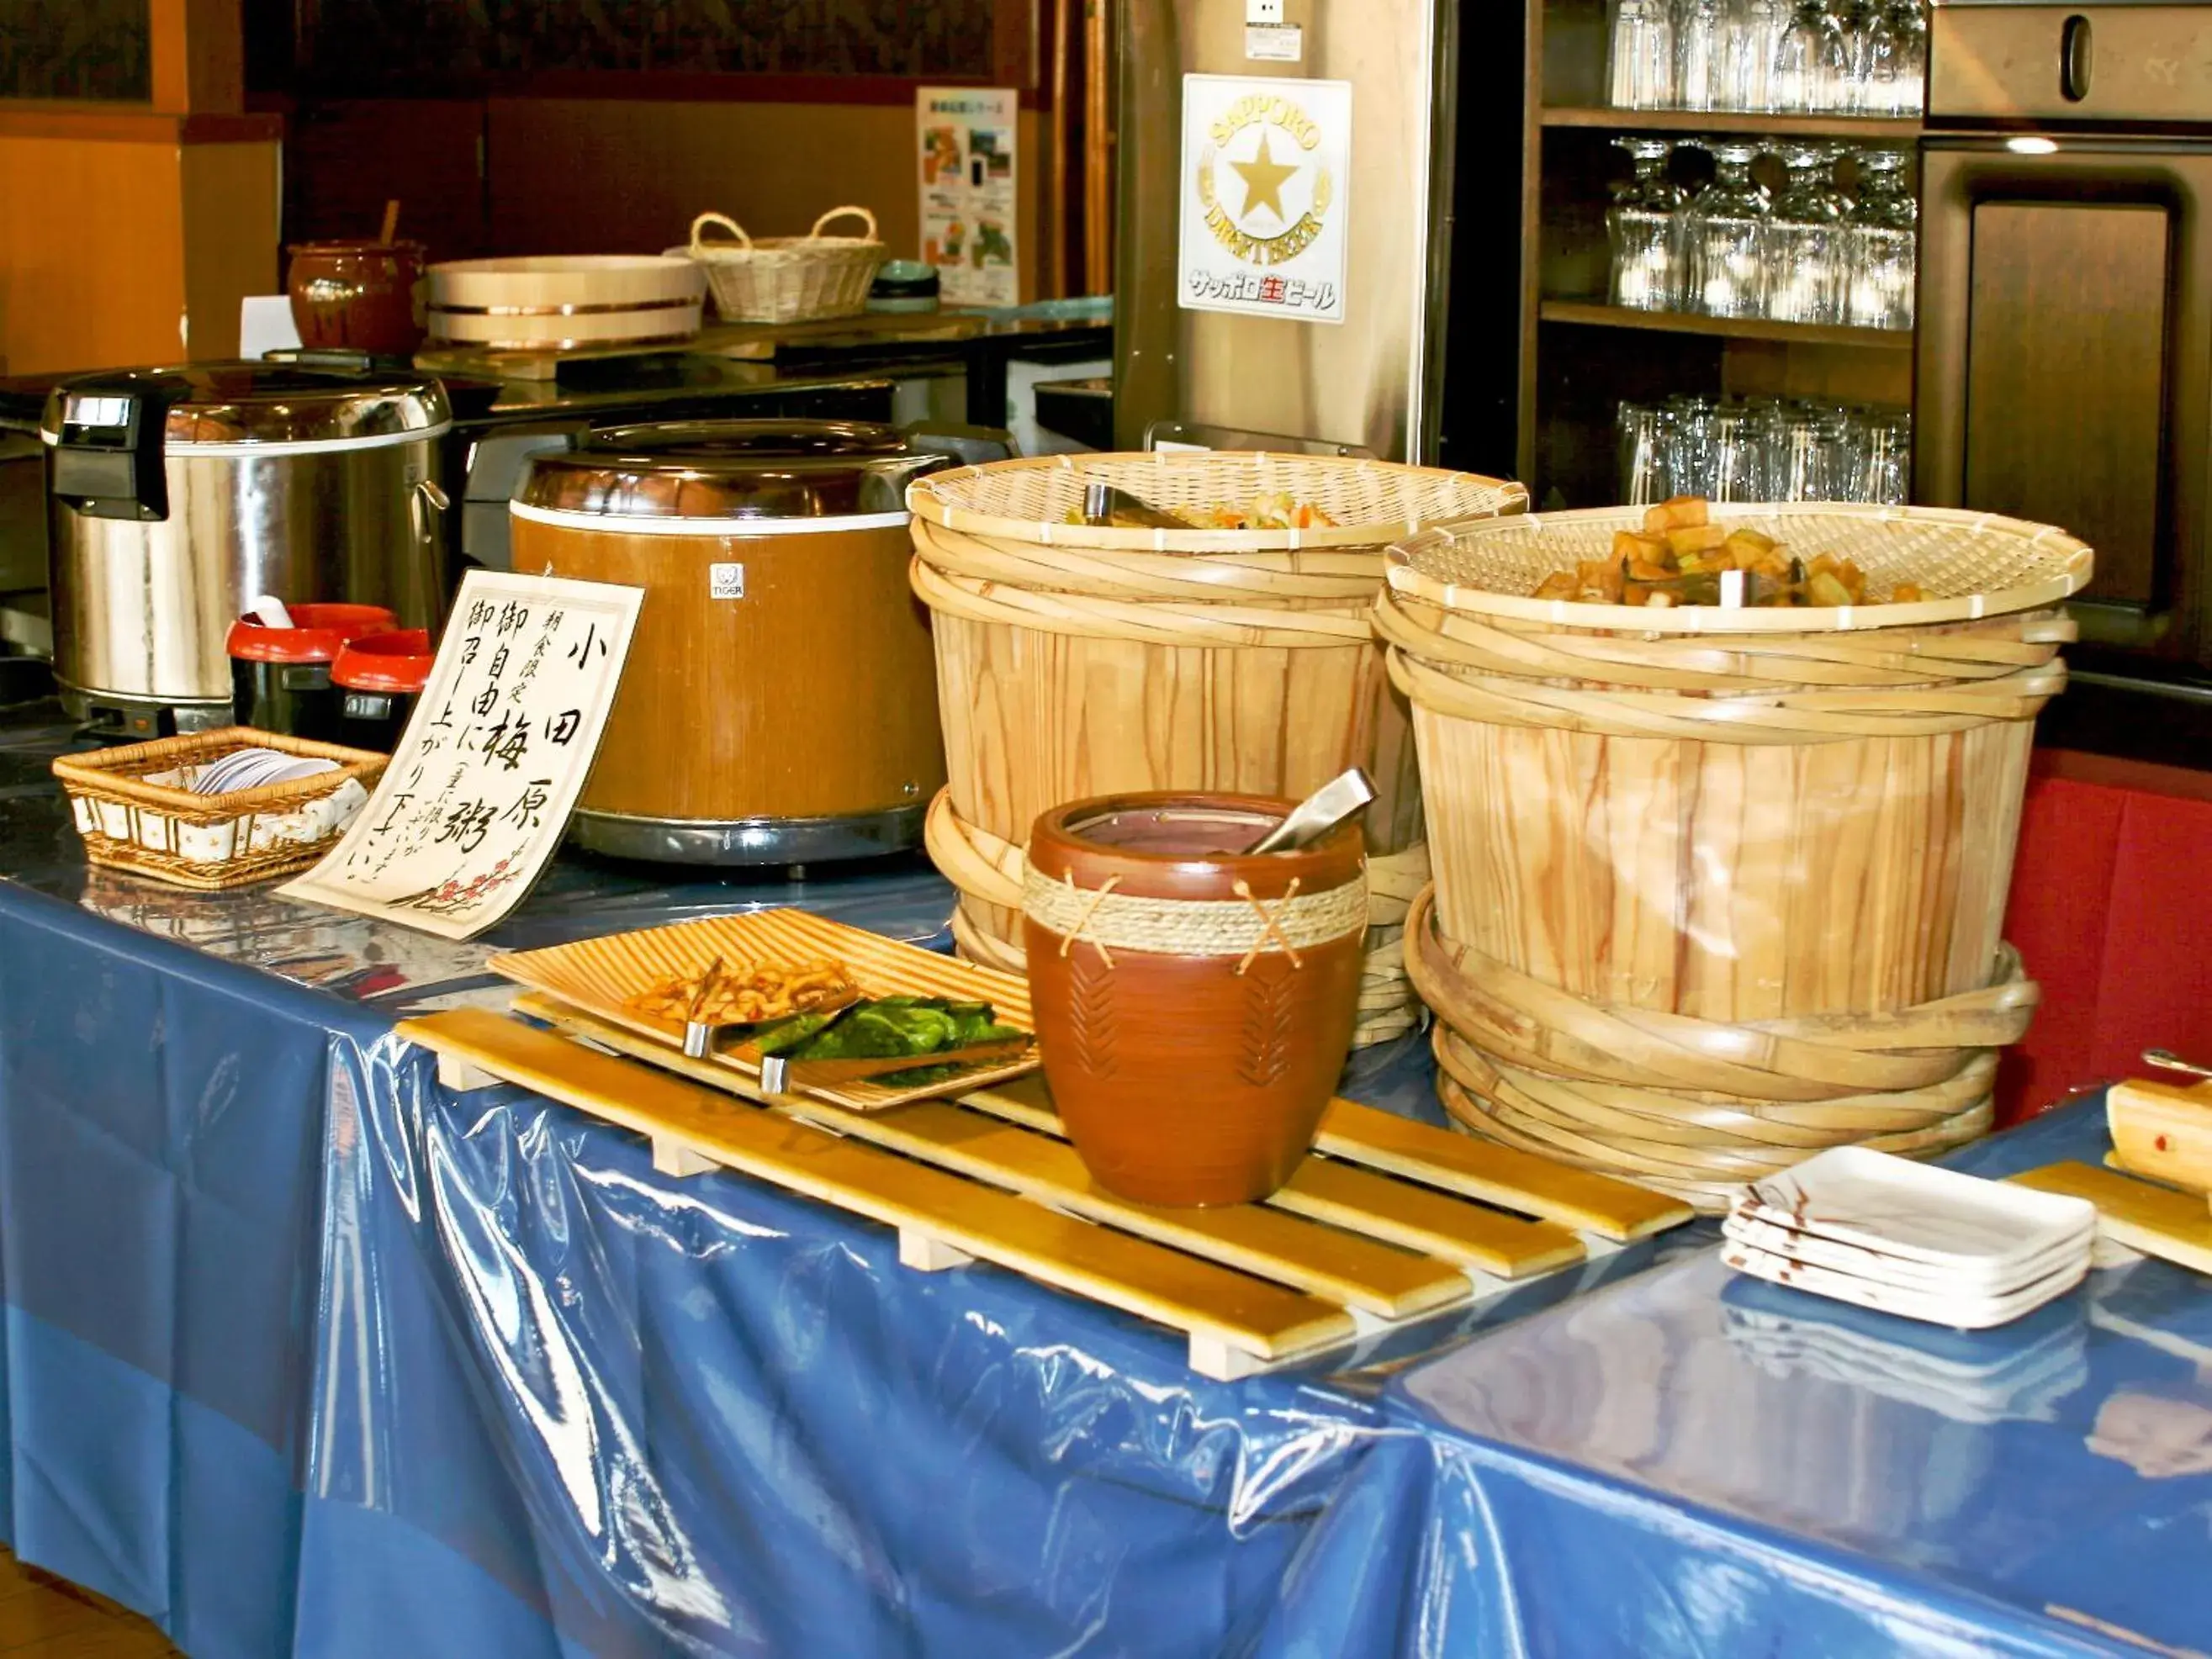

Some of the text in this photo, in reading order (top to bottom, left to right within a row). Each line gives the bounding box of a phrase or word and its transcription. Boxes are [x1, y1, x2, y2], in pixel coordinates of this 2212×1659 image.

[1209, 93, 1320, 151] SAPPORO
[1189, 269, 1336, 310] サッポロ生ビール
[713, 586, 743, 595] TIGER
[457, 601, 527, 752] 御自由に
[508, 610, 564, 704] 朝食限定
[500, 623, 606, 830] 小田原
[435, 709, 532, 853] 梅粥
